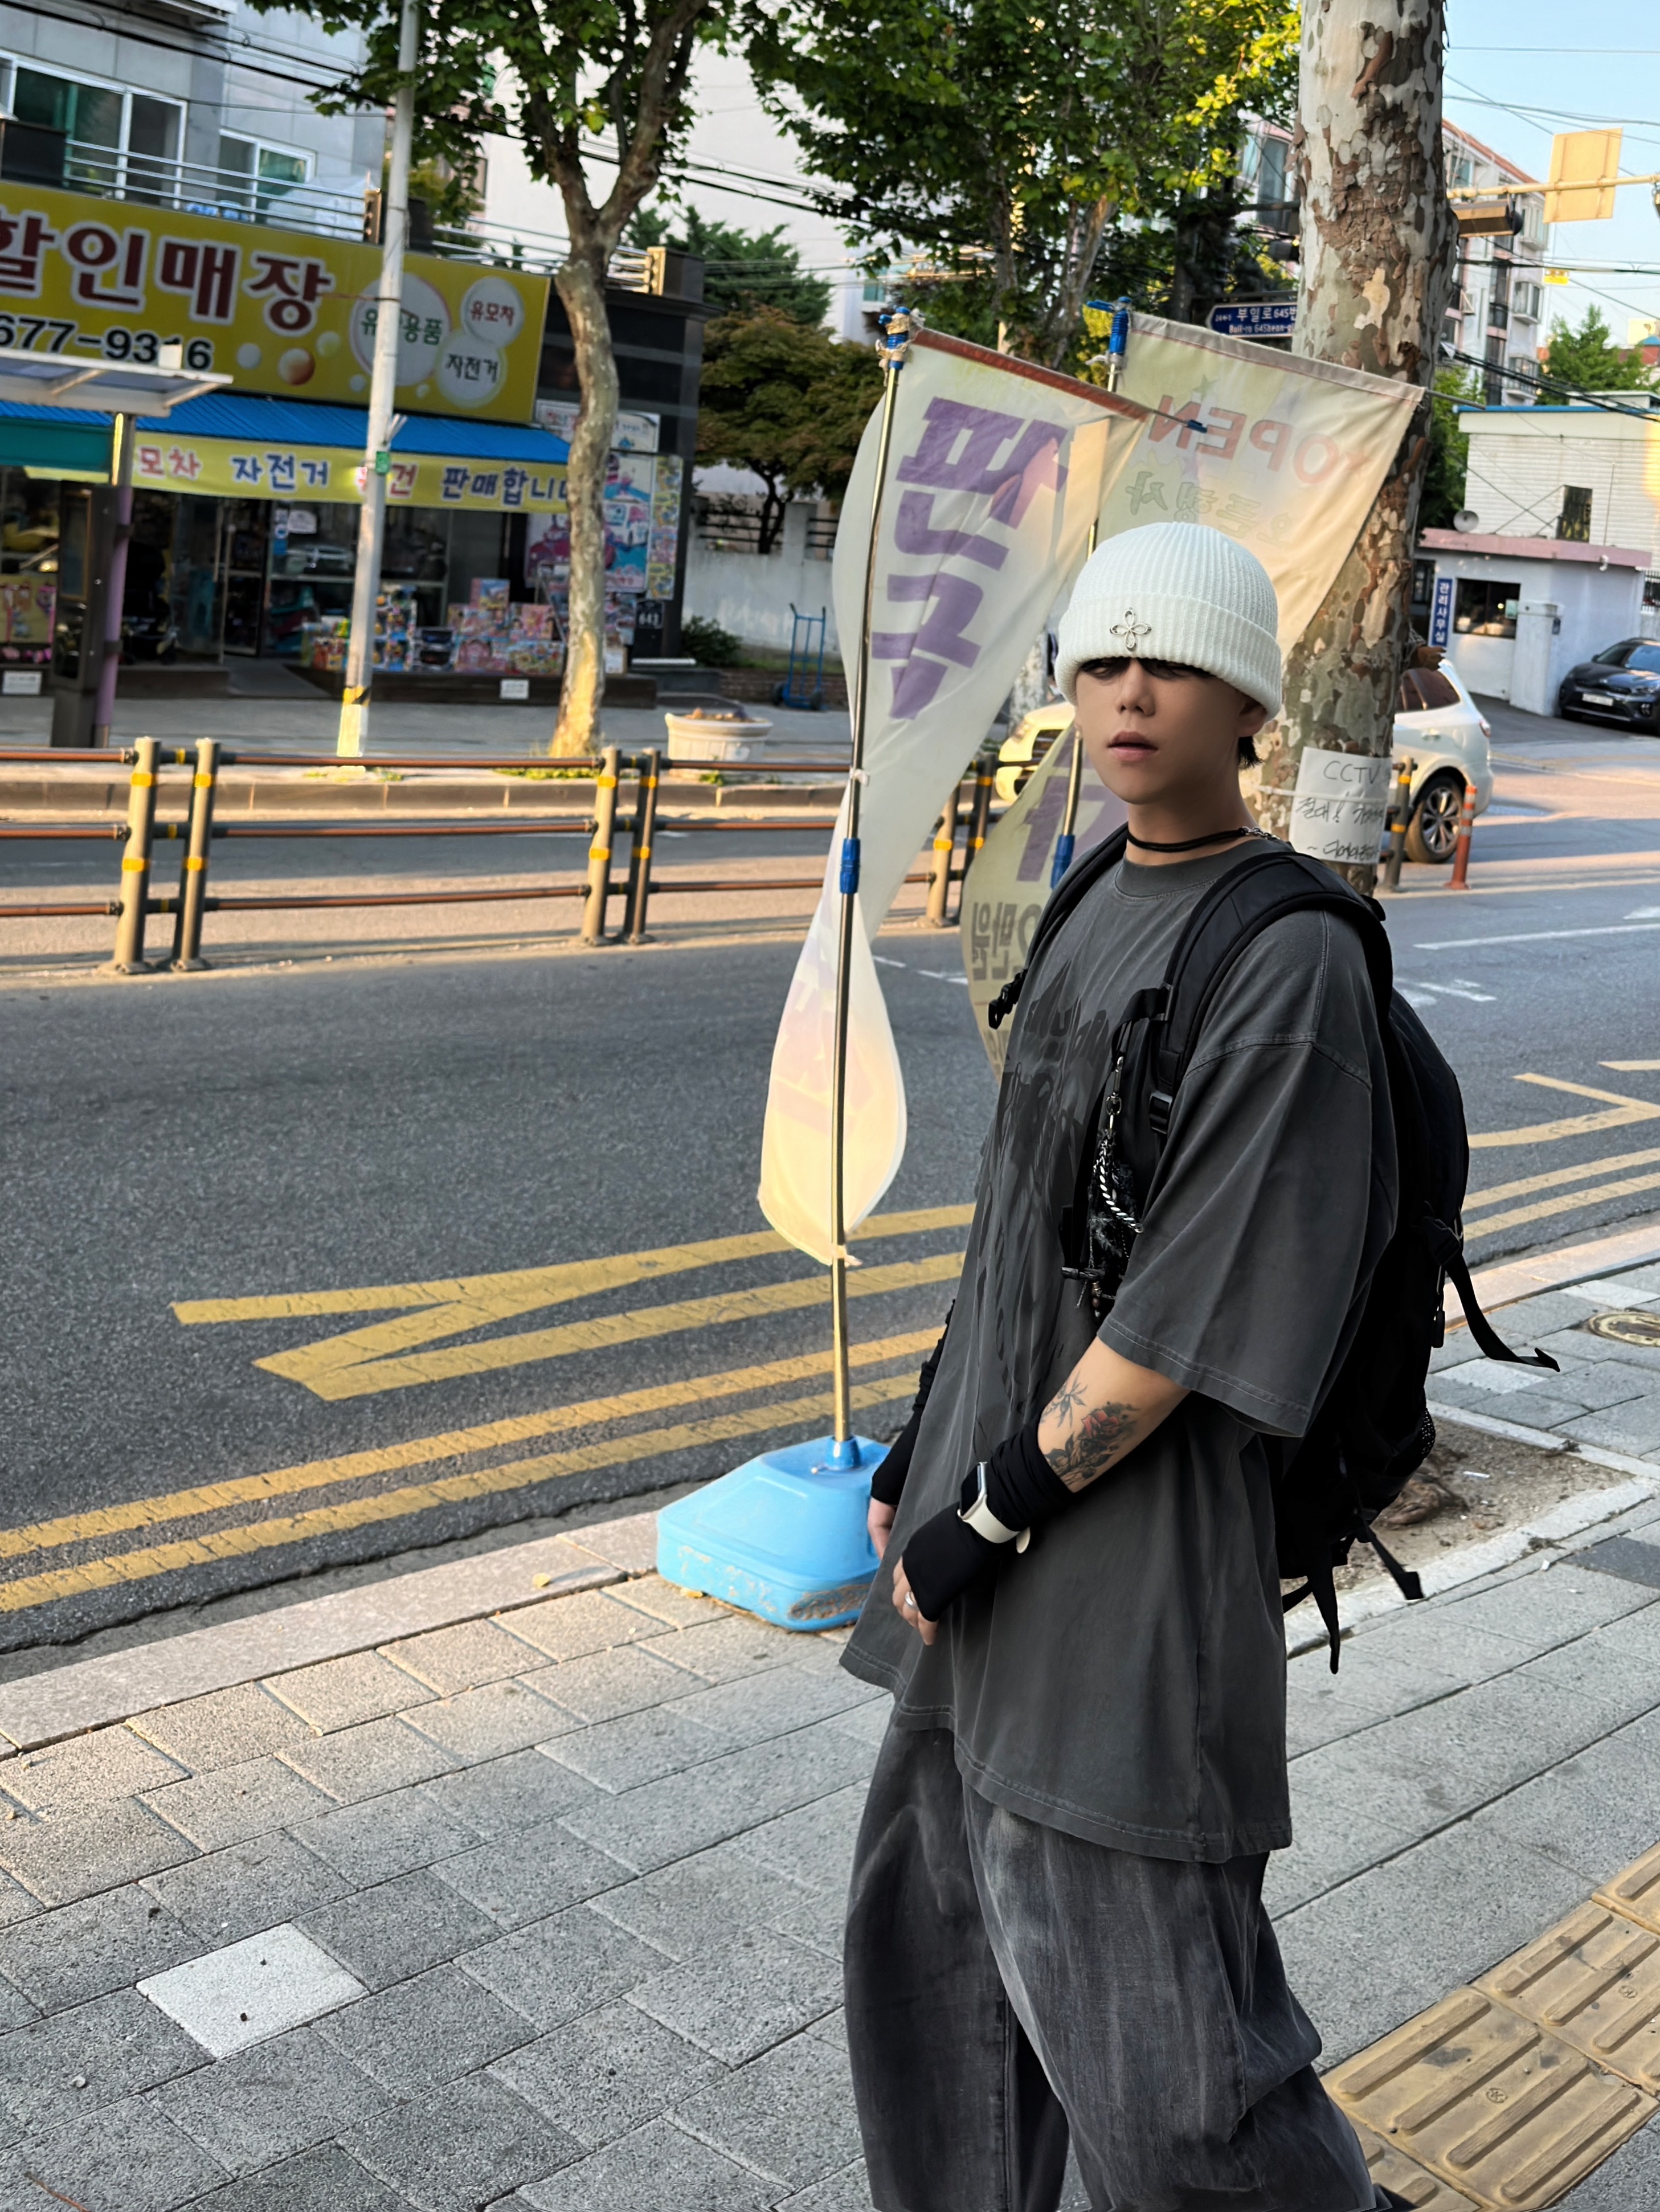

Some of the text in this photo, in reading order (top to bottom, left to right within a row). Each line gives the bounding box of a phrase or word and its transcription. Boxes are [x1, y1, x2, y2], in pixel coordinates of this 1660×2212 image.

[361, 308, 443, 346] 유용품
[471, 300, 515, 327] 유모차
[0, 316, 212, 369] 677-936
[1229, 324, 1253, 334] Buil-ro
[445, 353, 498, 383] 자전거
[233, 454, 329, 490] 자전거
[1323, 760, 1381, 784] CCTV
